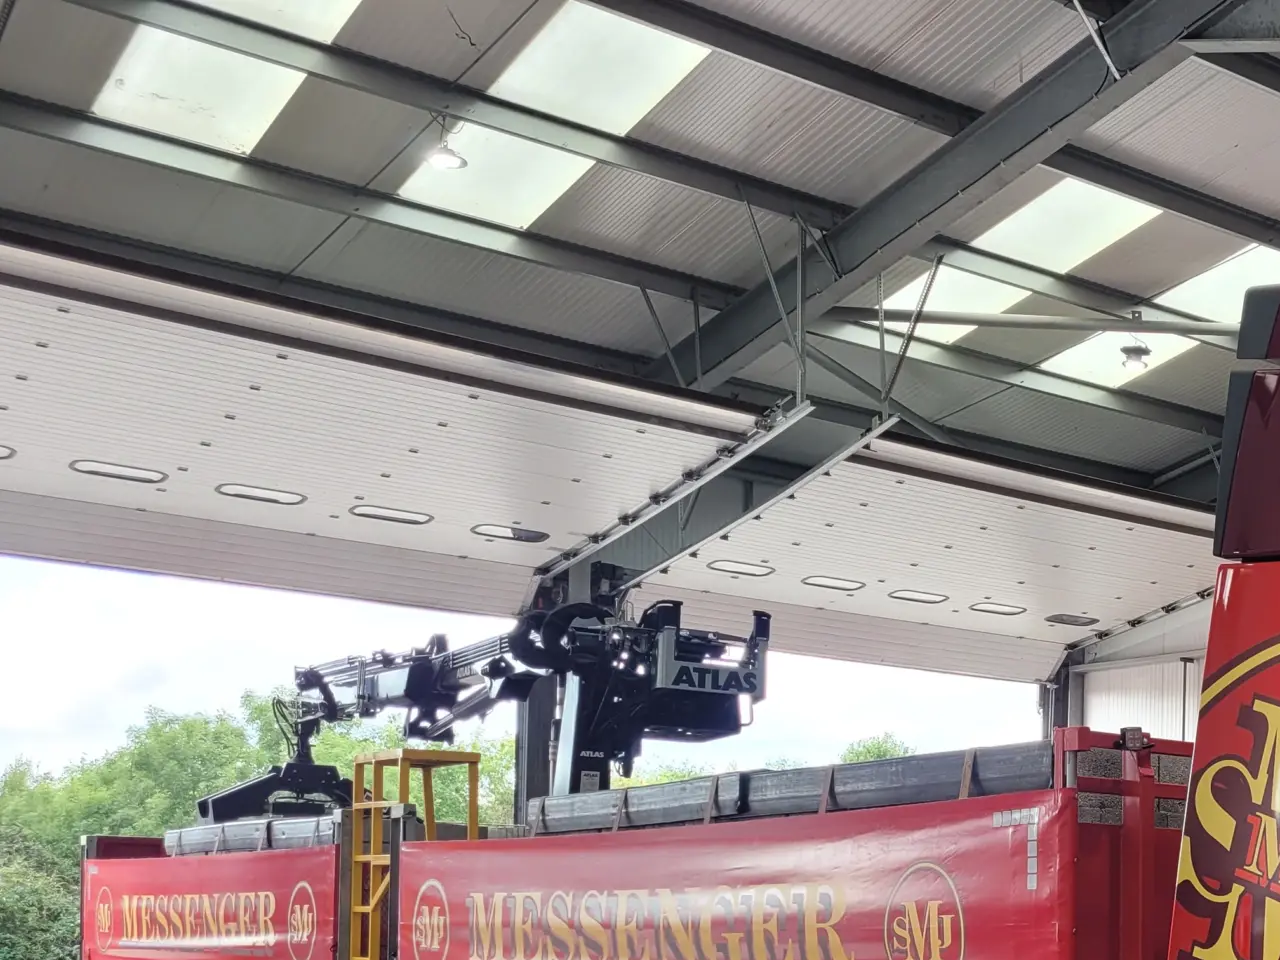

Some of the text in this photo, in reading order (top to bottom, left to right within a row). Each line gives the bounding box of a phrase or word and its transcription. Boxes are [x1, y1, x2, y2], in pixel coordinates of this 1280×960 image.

[671, 664, 758, 693] ATLAS
[580, 750, 604, 758] ATLAS
[121, 891, 278, 947] MESSENGER
